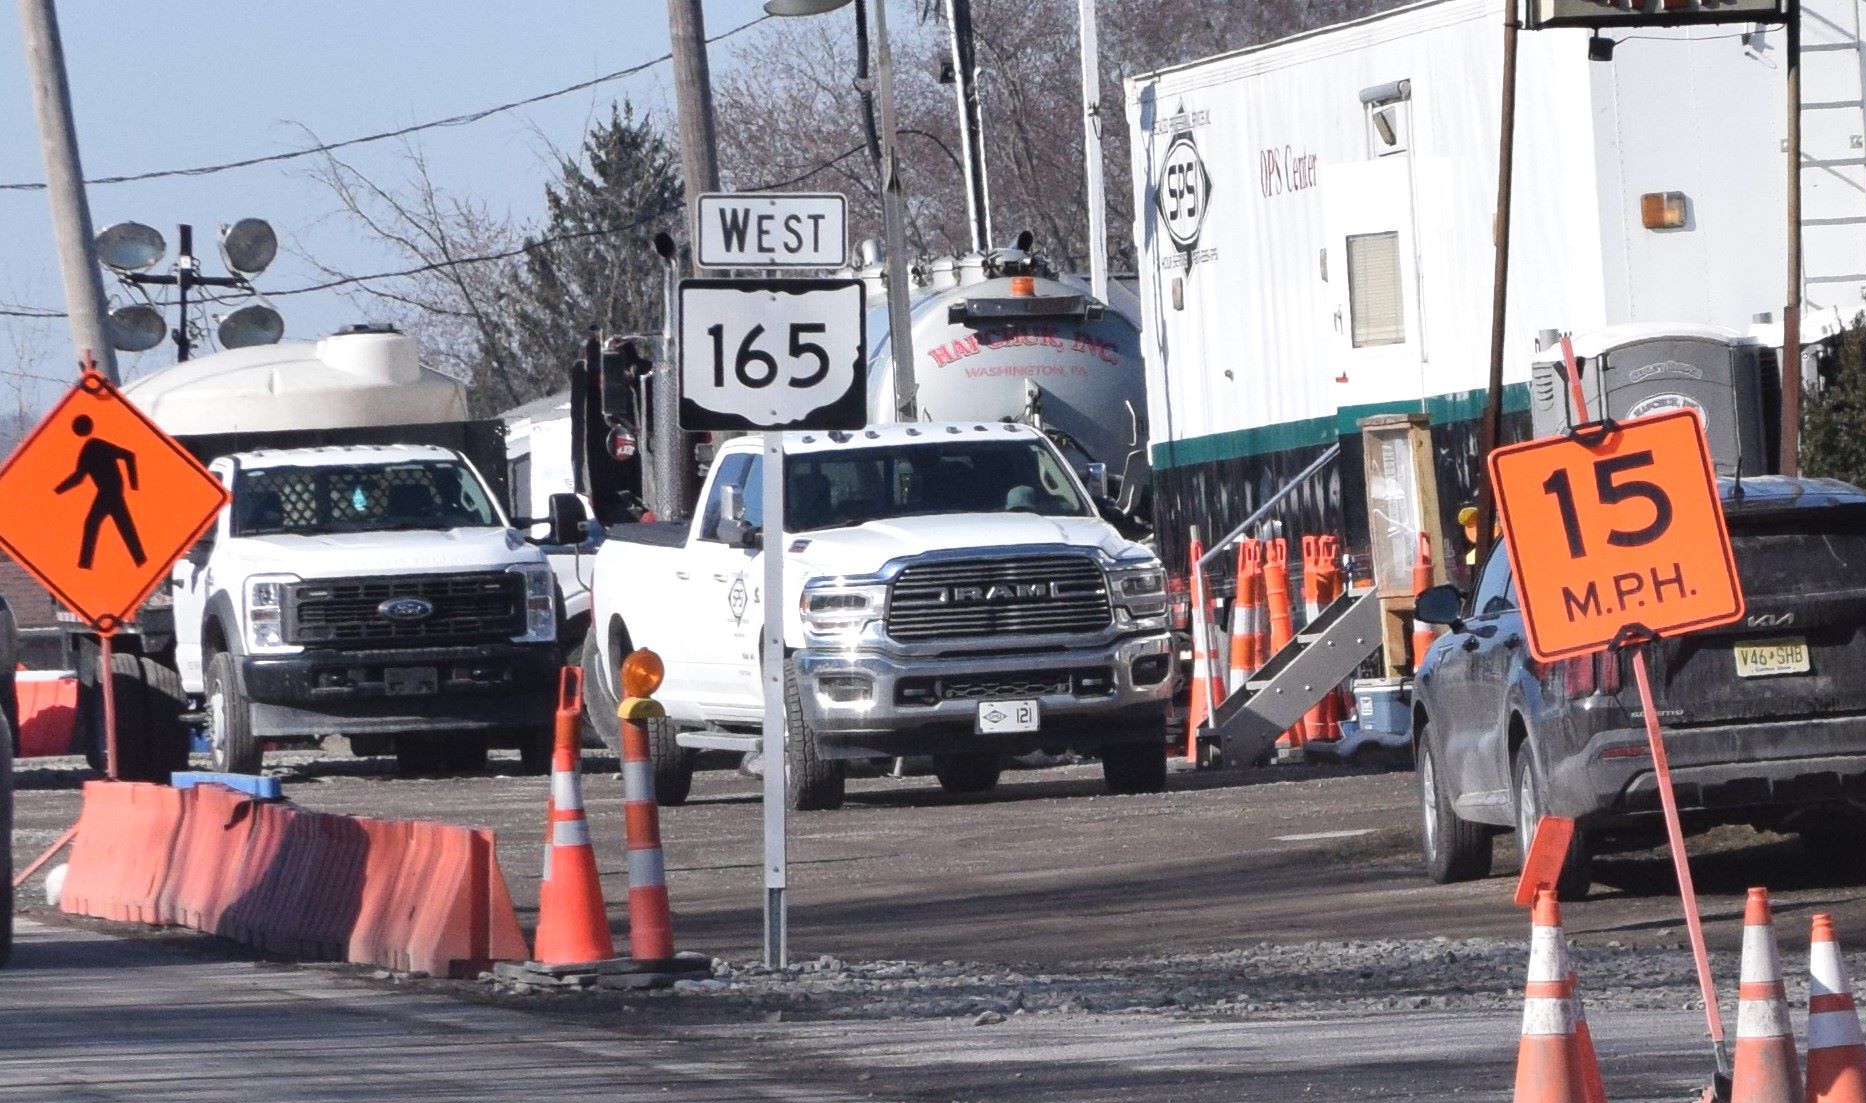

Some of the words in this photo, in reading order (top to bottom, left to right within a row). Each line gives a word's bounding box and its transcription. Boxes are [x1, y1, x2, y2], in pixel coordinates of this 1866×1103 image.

[1260, 148, 1283, 198] OPS
[719, 208, 826, 253] WEST
[707, 322, 831, 389] 165
[1542, 449, 1673, 559] 15
[954, 584, 1046, 600] RAM
[1561, 562, 1697, 623] M.P.H.
